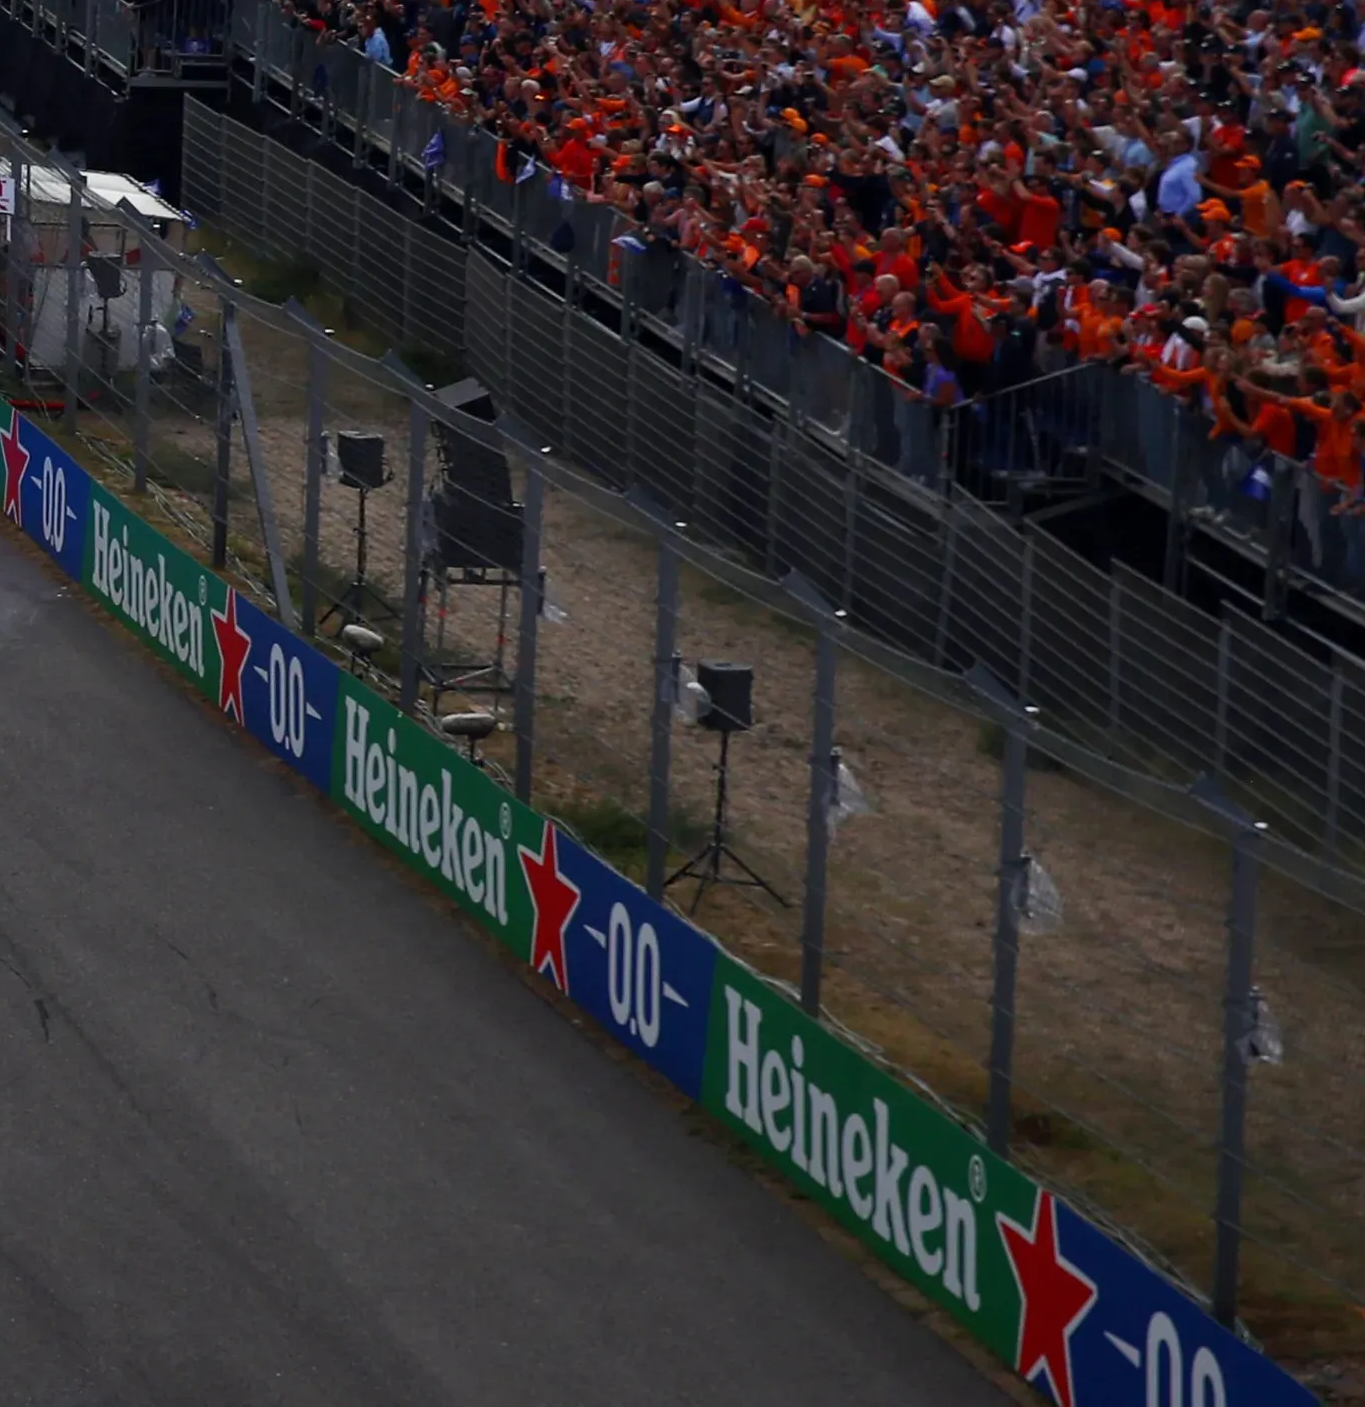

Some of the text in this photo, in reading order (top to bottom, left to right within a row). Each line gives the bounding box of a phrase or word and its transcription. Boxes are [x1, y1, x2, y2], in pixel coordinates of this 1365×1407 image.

[42, 456, 66, 553] 0.0
[92, 498, 205, 678] Heineken
[269, 643, 305, 757] 0.0
[344, 694, 508, 926] Heineken
[607, 902, 661, 1047] 0.0
[725, 984, 981, 1311] Heineken
